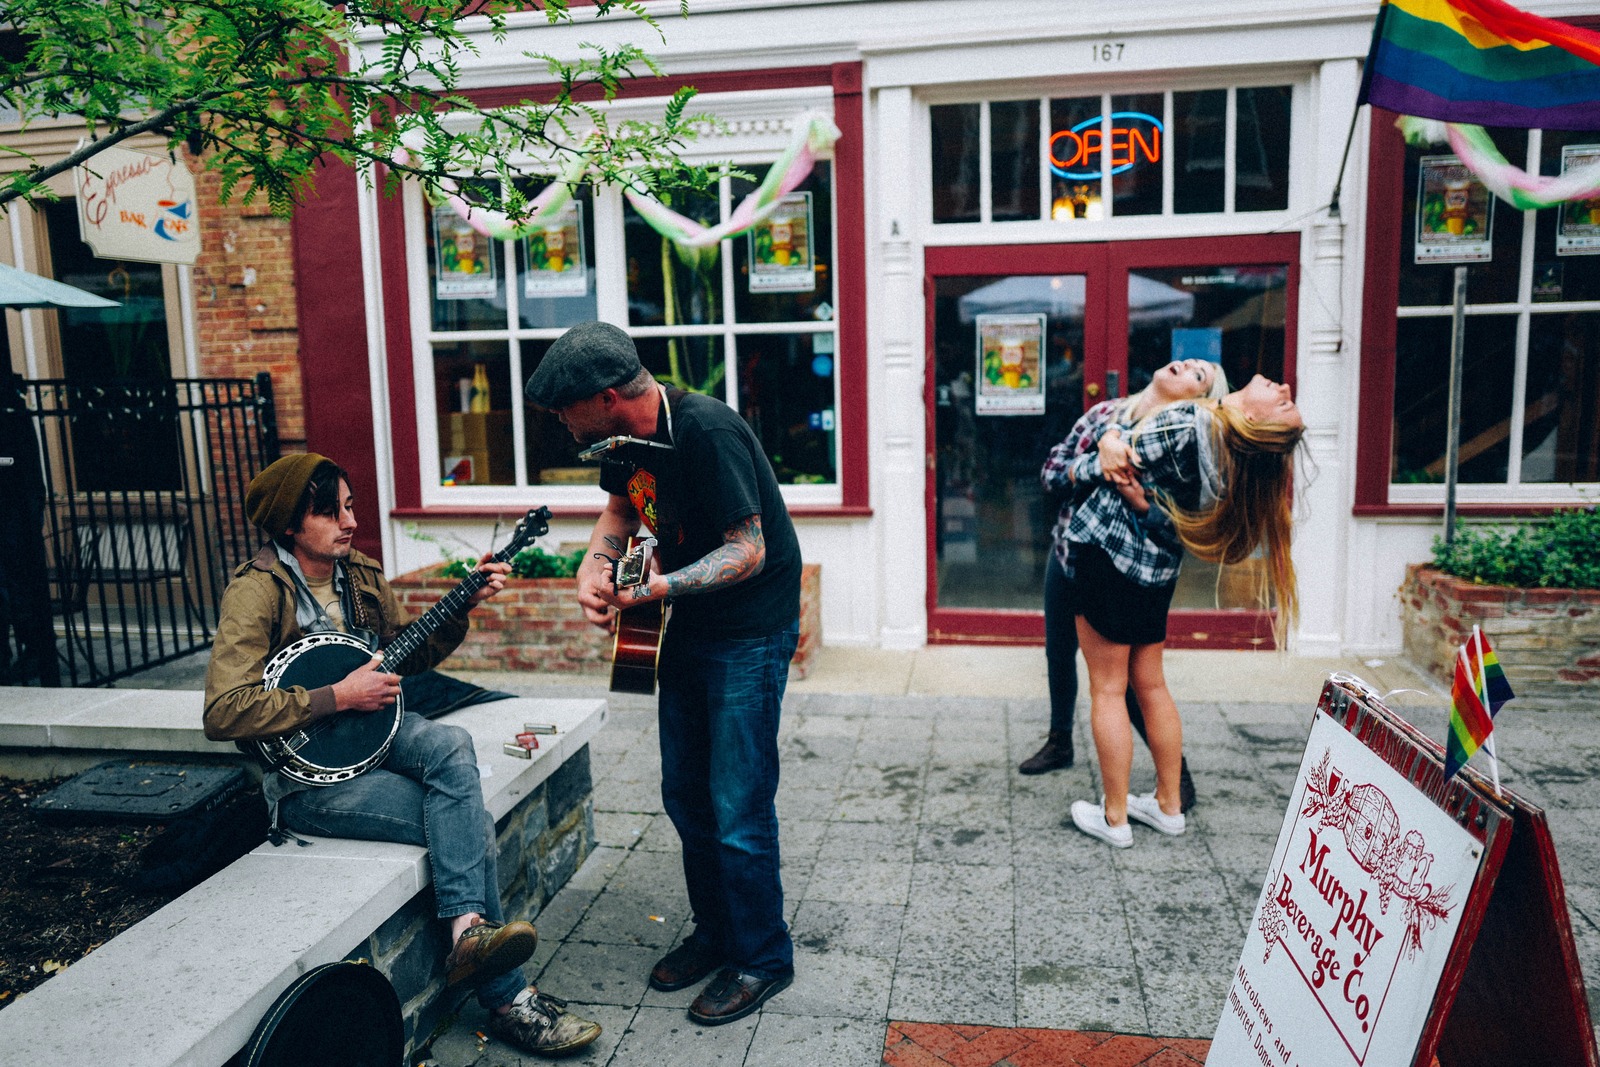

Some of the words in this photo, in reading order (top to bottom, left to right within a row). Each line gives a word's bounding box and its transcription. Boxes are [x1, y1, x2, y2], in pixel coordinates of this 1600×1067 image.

[1092, 43, 1126, 62] 167
[1049, 126, 1161, 168] OPEN
[119, 209, 148, 229] BAR
[1299, 827, 1385, 968] Murphy
[1276, 872, 1341, 989] Beverage
[1343, 968, 1370, 1034] Co.
[1228, 984, 1256, 1041] Imported,
[1254, 1031, 1276, 1067] Dome
[1236, 964, 1274, 1035] Microbrews
[1274, 1036, 1292, 1065] and
